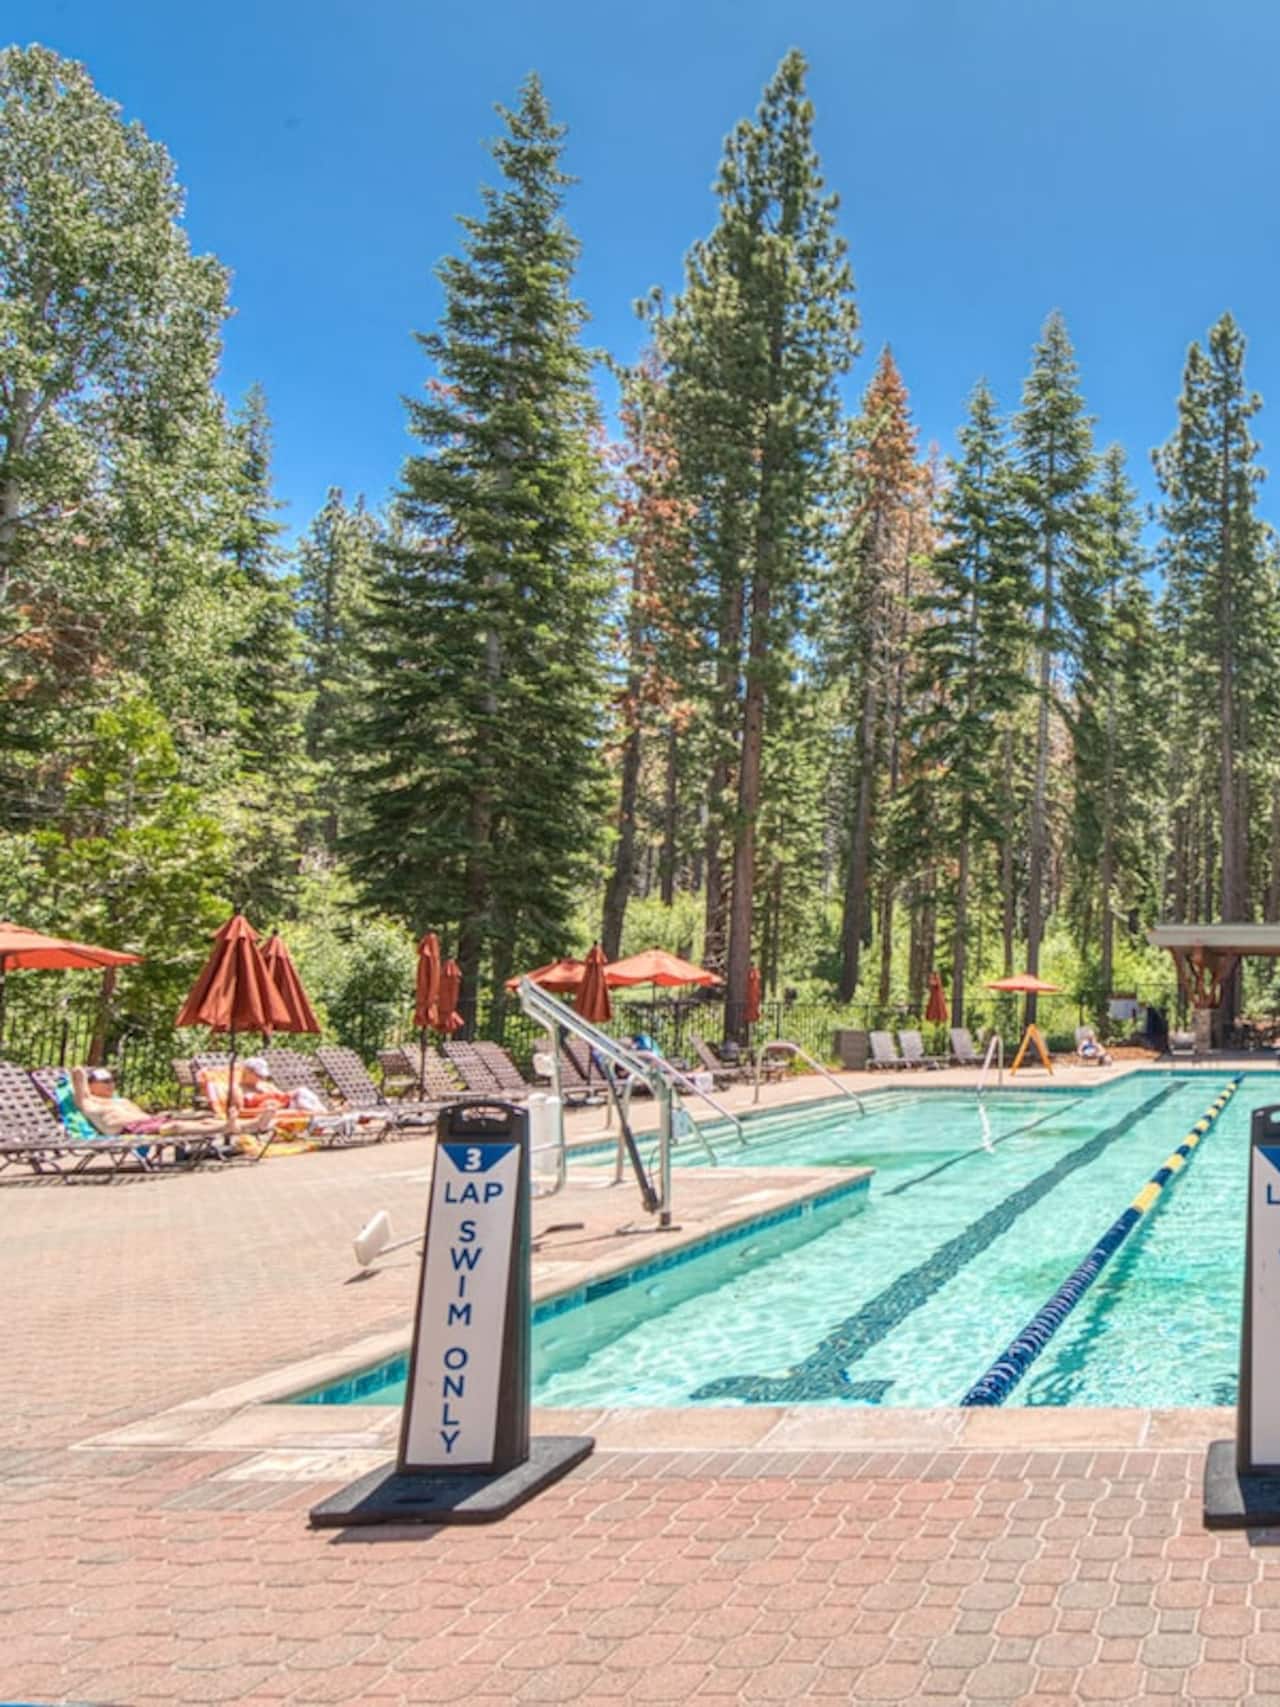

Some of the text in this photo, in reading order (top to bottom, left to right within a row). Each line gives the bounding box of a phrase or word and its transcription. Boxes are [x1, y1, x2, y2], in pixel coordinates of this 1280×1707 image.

[464, 1148, 482, 1171] 3
[445, 1183, 503, 1204] LAP
[442, 1220, 482, 1453] SWIM ONLY
